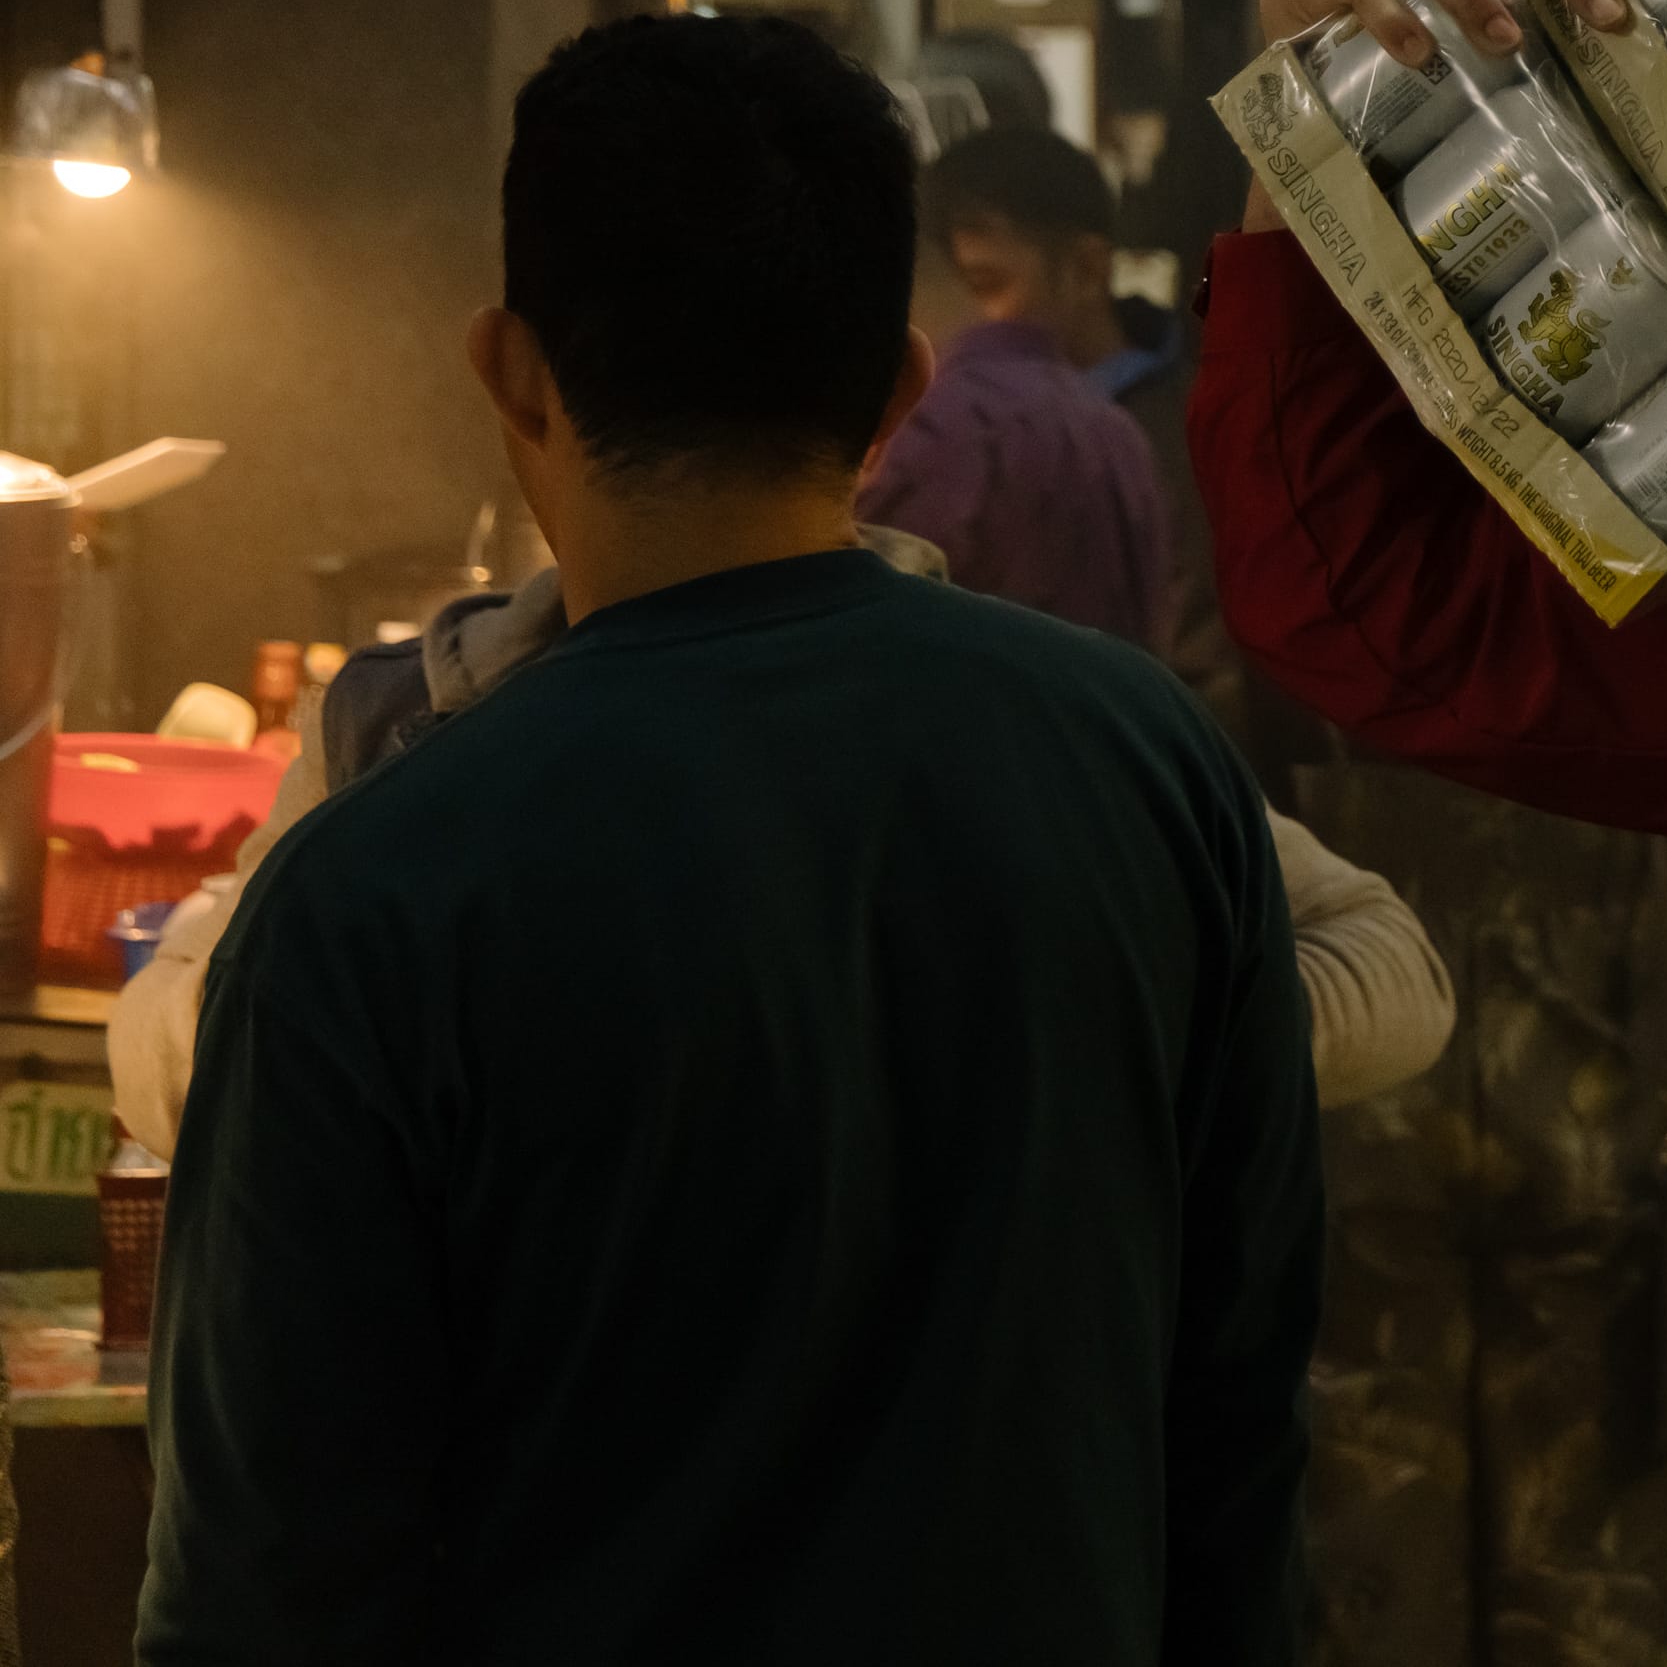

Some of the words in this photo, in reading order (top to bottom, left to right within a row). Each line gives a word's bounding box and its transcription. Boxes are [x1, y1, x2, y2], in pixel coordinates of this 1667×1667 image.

[1576, 36, 1664, 172] SINGHA
[1267, 147, 1367, 287] SINGHA
[1485, 217, 1531, 263] 1933
[1402, 284, 1434, 327] MFG
[1432, 328, 1520, 440] 2020/12/22
[1488, 315, 1565, 416] SINGHA
[1362, 290, 1384, 311] 24
[1378, 312, 1399, 333] 33
[1454, 420, 1495, 463] WEIGHT
[1487, 453, 1511, 478] 8.5
[1515, 482, 1541, 508] THE
[1531, 500, 1577, 548] ORIGINAL
[1566, 539, 1596, 569] THAI
[1585, 558, 1619, 593] BEER
